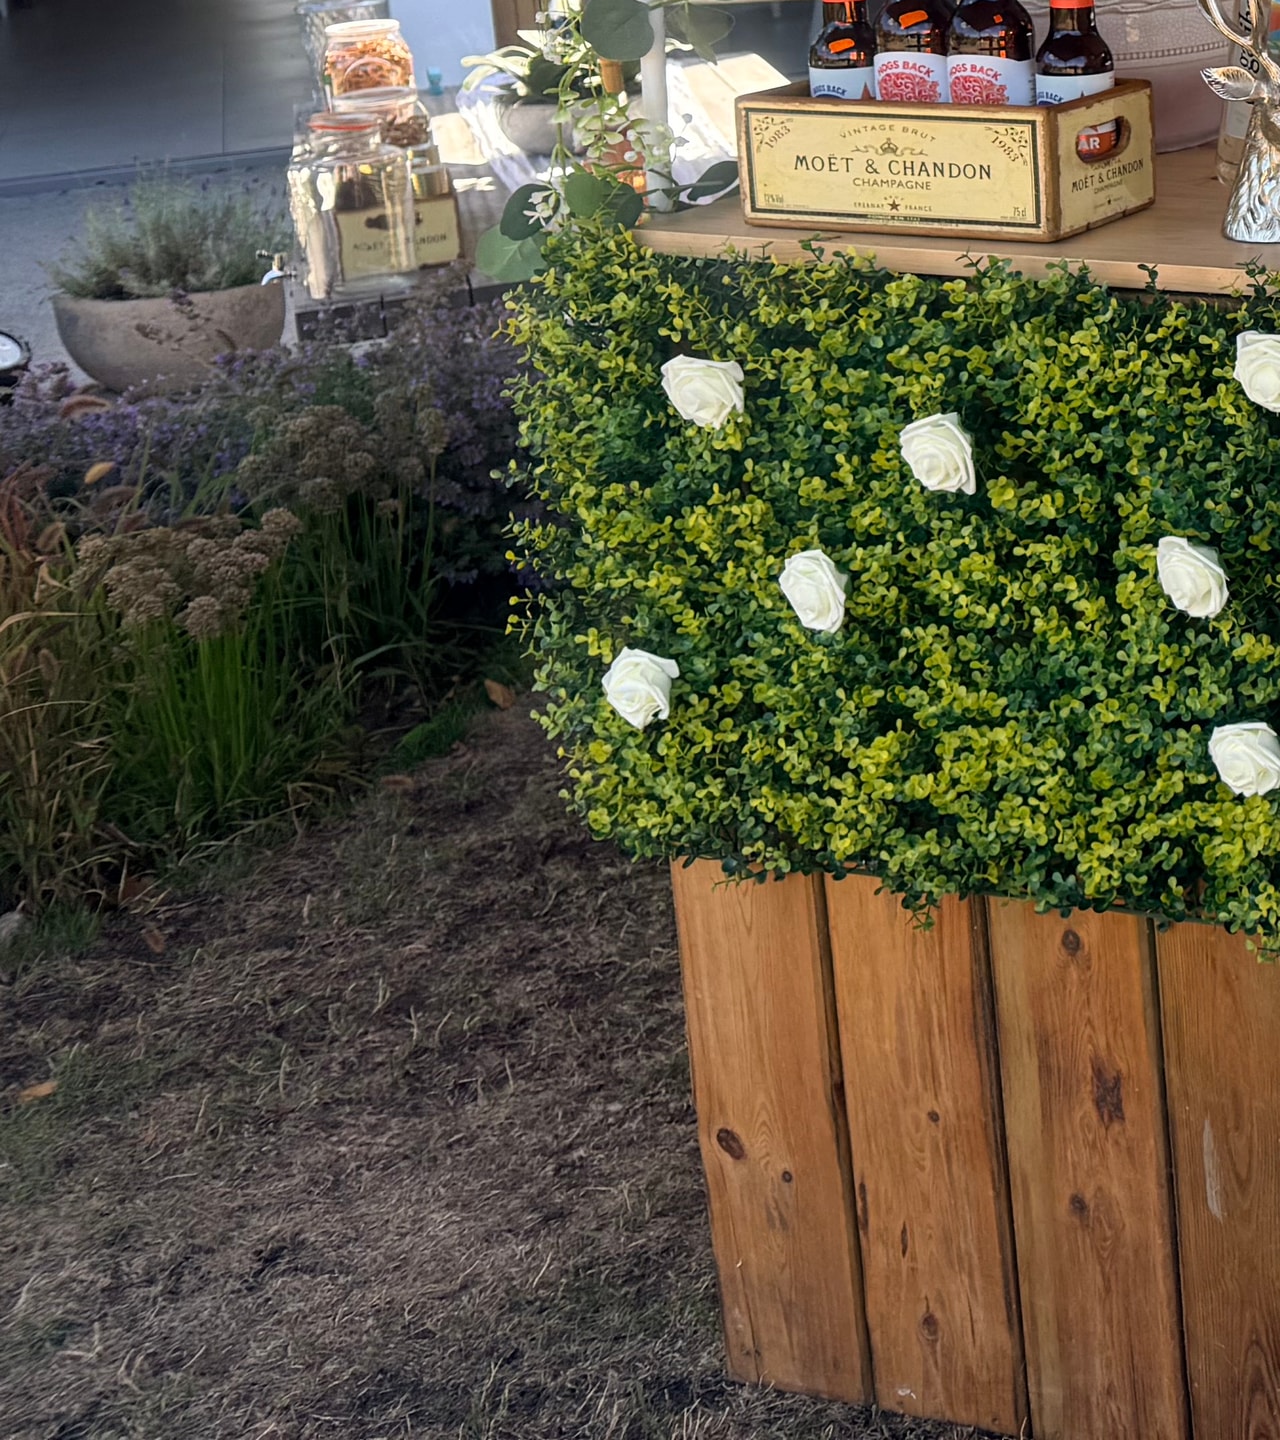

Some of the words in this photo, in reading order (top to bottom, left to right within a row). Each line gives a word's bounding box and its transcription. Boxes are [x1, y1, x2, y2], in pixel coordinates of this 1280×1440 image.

[902, 60, 935, 78] BACK
[970, 63, 1002, 81] BACK
[827, 84, 847, 96] BACK
[764, 125, 791, 149] 1983
[840, 124, 895, 139] VINTAGE
[902, 126, 936, 143] BRUT
[990, 136, 1020, 163] 1983
[794, 153, 854, 173] MOËT
[865, 158, 880, 175] &
[887, 159, 992, 181] CHANDON
[1106, 159, 1144, 181] CHANDON
[852, 177, 932, 191] CHAMPAGNE
